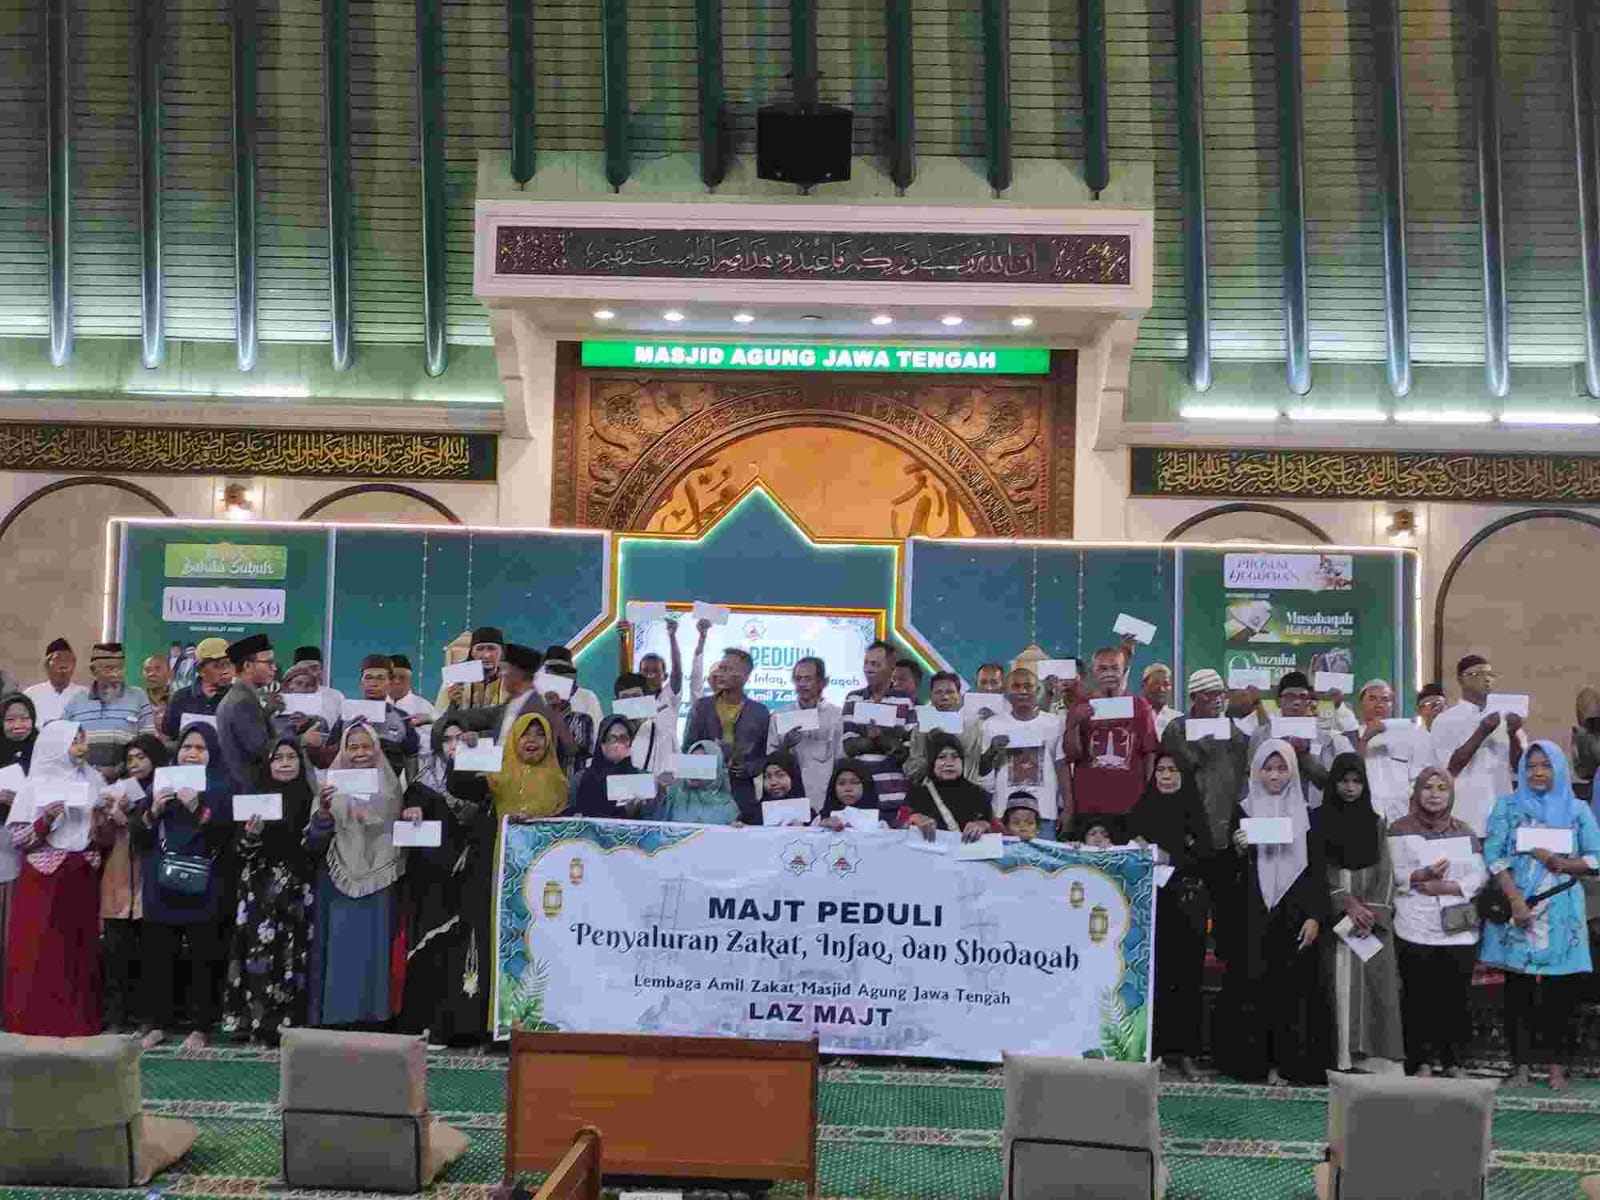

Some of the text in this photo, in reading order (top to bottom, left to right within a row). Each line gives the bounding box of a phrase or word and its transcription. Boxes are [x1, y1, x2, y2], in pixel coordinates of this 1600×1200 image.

[634, 346, 996, 369] MASJID AGUNG JAWA TENGAH
[708, 896, 943, 927] MAJT PEDULI
[569, 922, 1080, 975] Penyaluran Zakat, Infaq, dan Shodaqah
[634, 974, 702, 992] Lembaga
[707, 977, 744, 992] Amil
[801, 981, 851, 998] Masjid
[858, 983, 907, 1001] Agung
[913, 986, 950, 1001] Jawa
[955, 988, 1011, 1006] Tengah
[749, 1002, 893, 1026] LAZ MAJT
